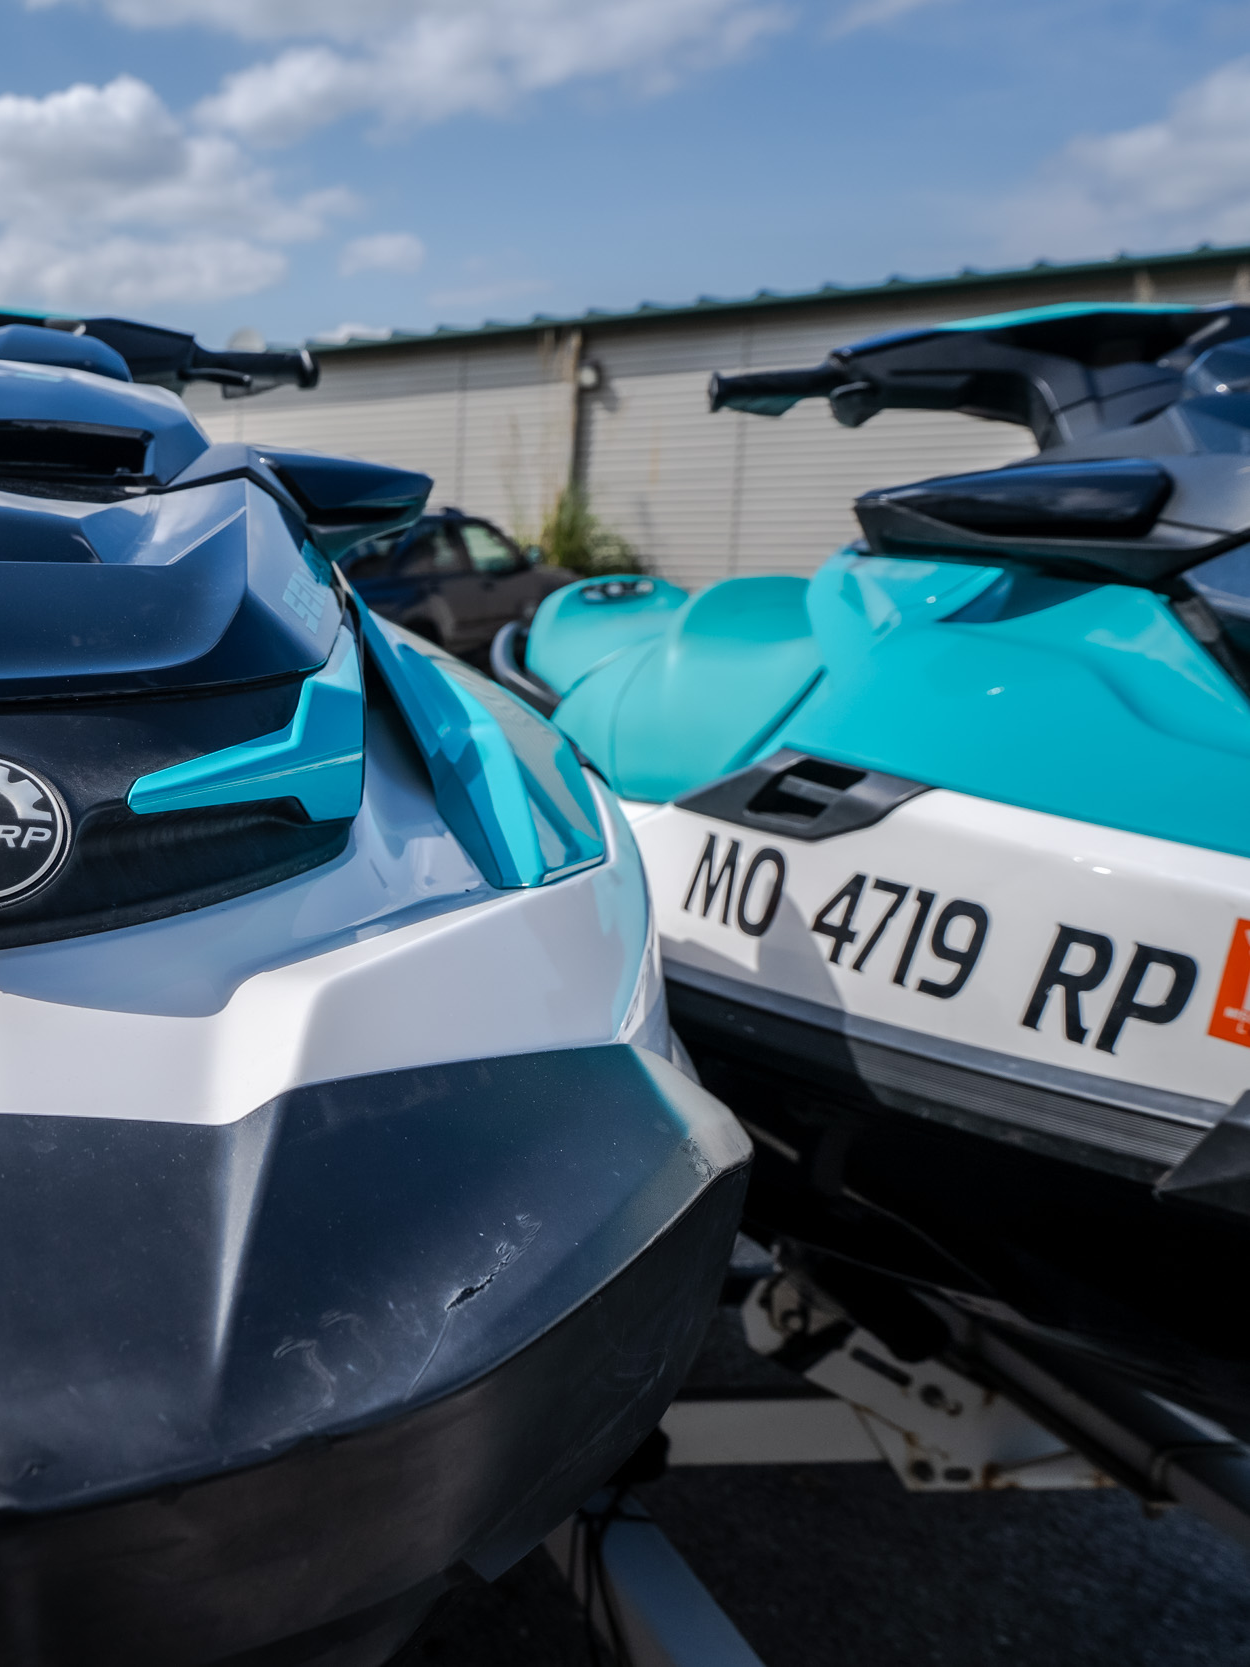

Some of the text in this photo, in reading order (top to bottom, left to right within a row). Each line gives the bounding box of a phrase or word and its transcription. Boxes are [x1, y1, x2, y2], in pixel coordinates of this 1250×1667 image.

[683, 833, 1198, 1055] MO 4719 RP
